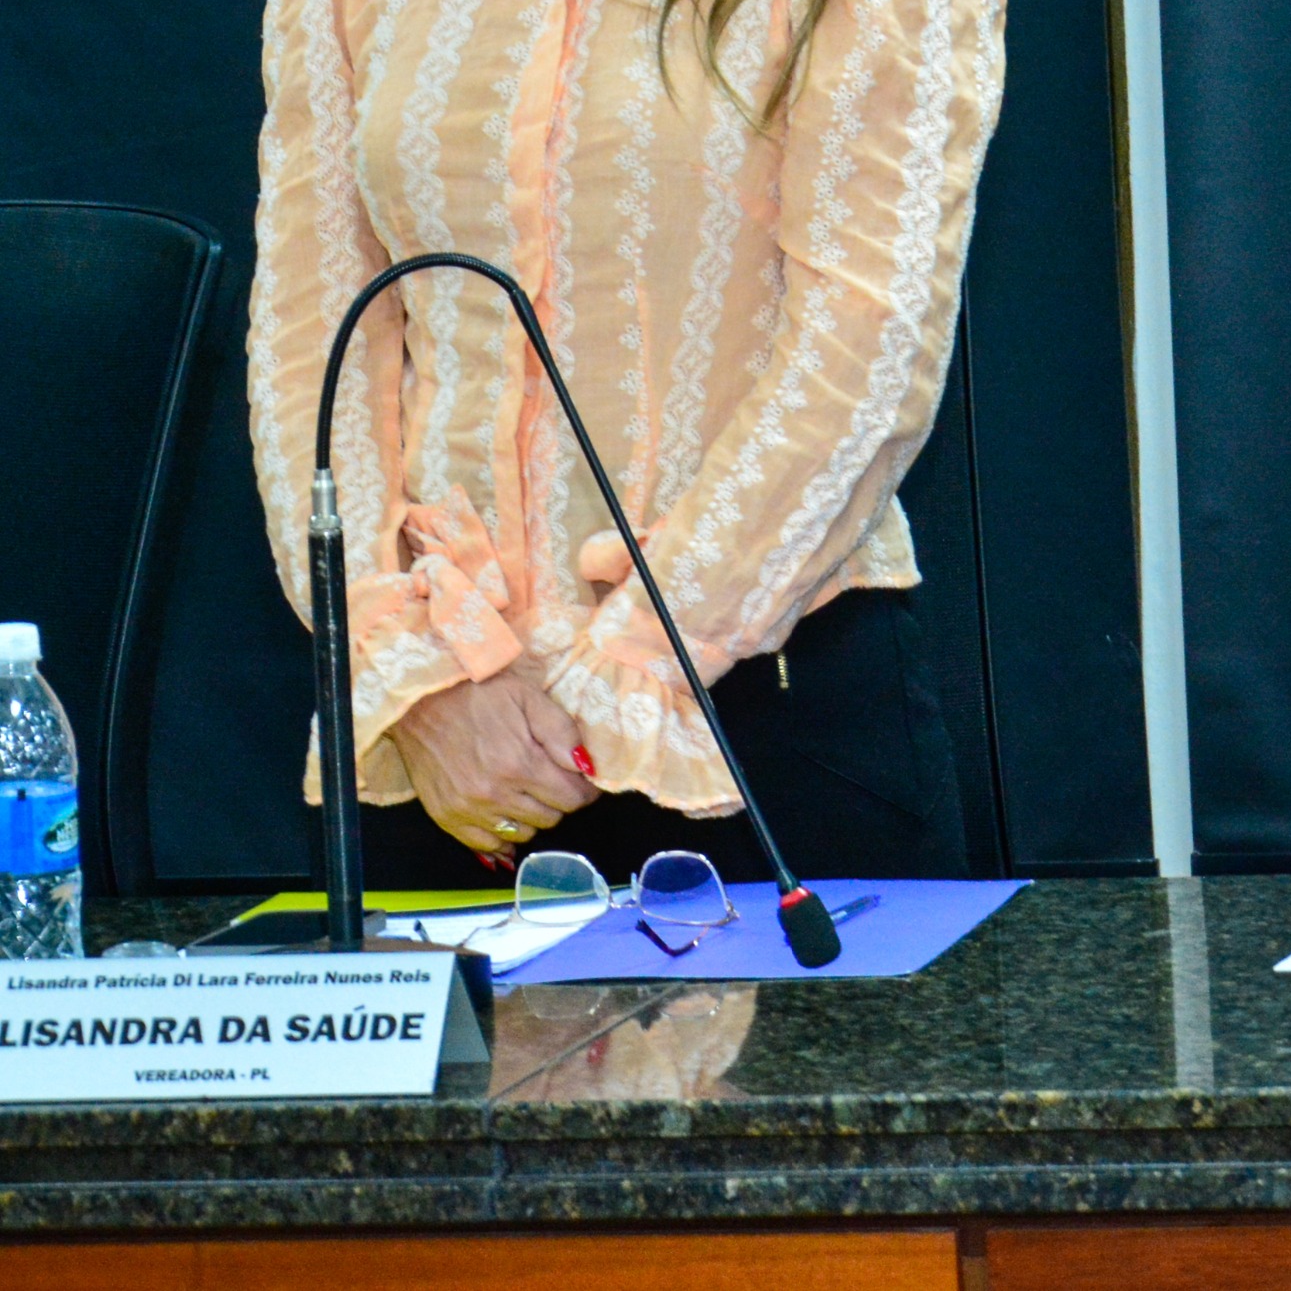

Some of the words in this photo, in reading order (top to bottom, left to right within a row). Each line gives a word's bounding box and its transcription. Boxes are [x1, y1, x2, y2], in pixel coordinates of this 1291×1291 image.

[6, 975, 89, 991] Lisandra
[93, 973, 168, 989] Patrícia
[197, 973, 239, 987] Lara
[244, 971, 319, 986] Ferreira
[324, 971, 384, 985] Nunes
[389, 969, 431, 984] Reis
[0, 1017, 203, 1047] LISANDRA
[218, 1016, 271, 1043] DA
[284, 1005, 425, 1042] SAÚDE
[134, 1068, 236, 1083] VEREADORA
[250, 1067, 271, 1081] PL
